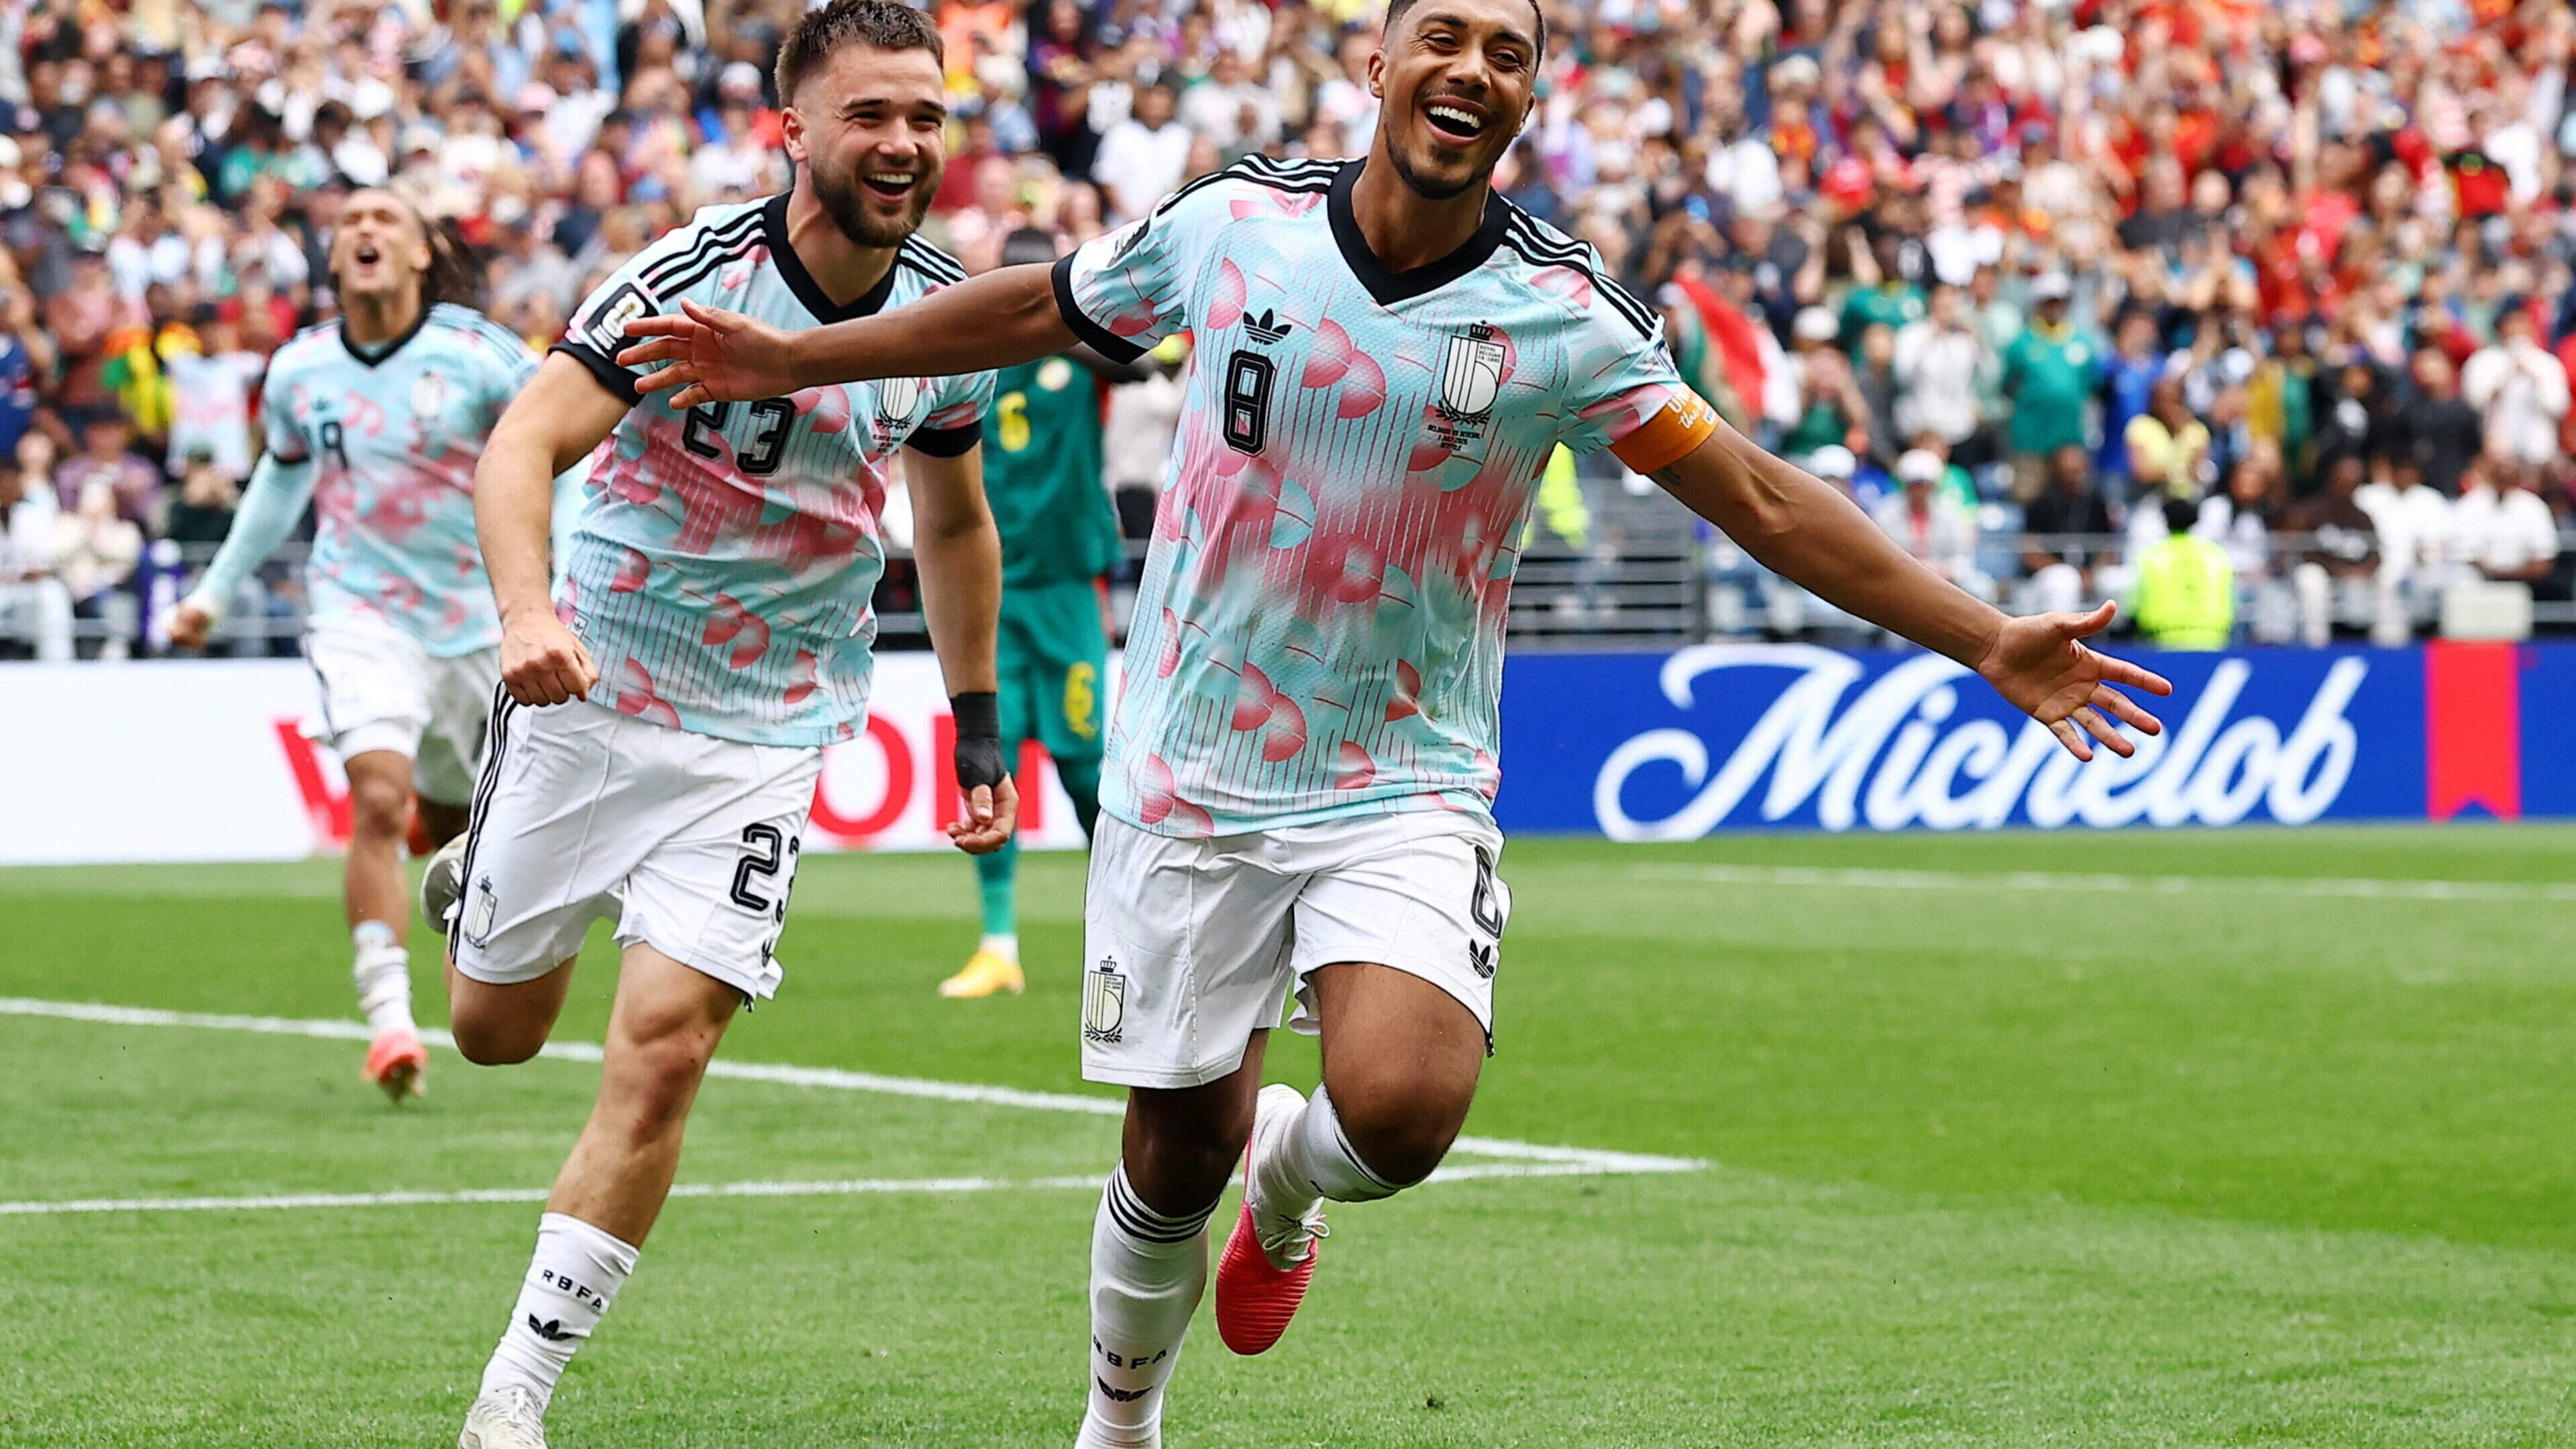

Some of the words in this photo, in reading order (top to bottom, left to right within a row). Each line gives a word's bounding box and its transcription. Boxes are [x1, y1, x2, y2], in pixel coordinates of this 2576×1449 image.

[682, 396, 800, 477] 23
[996, 391, 1031, 453] 6
[1223, 350, 1277, 458] 8
[541, 1269, 602, 1310] RBFA
